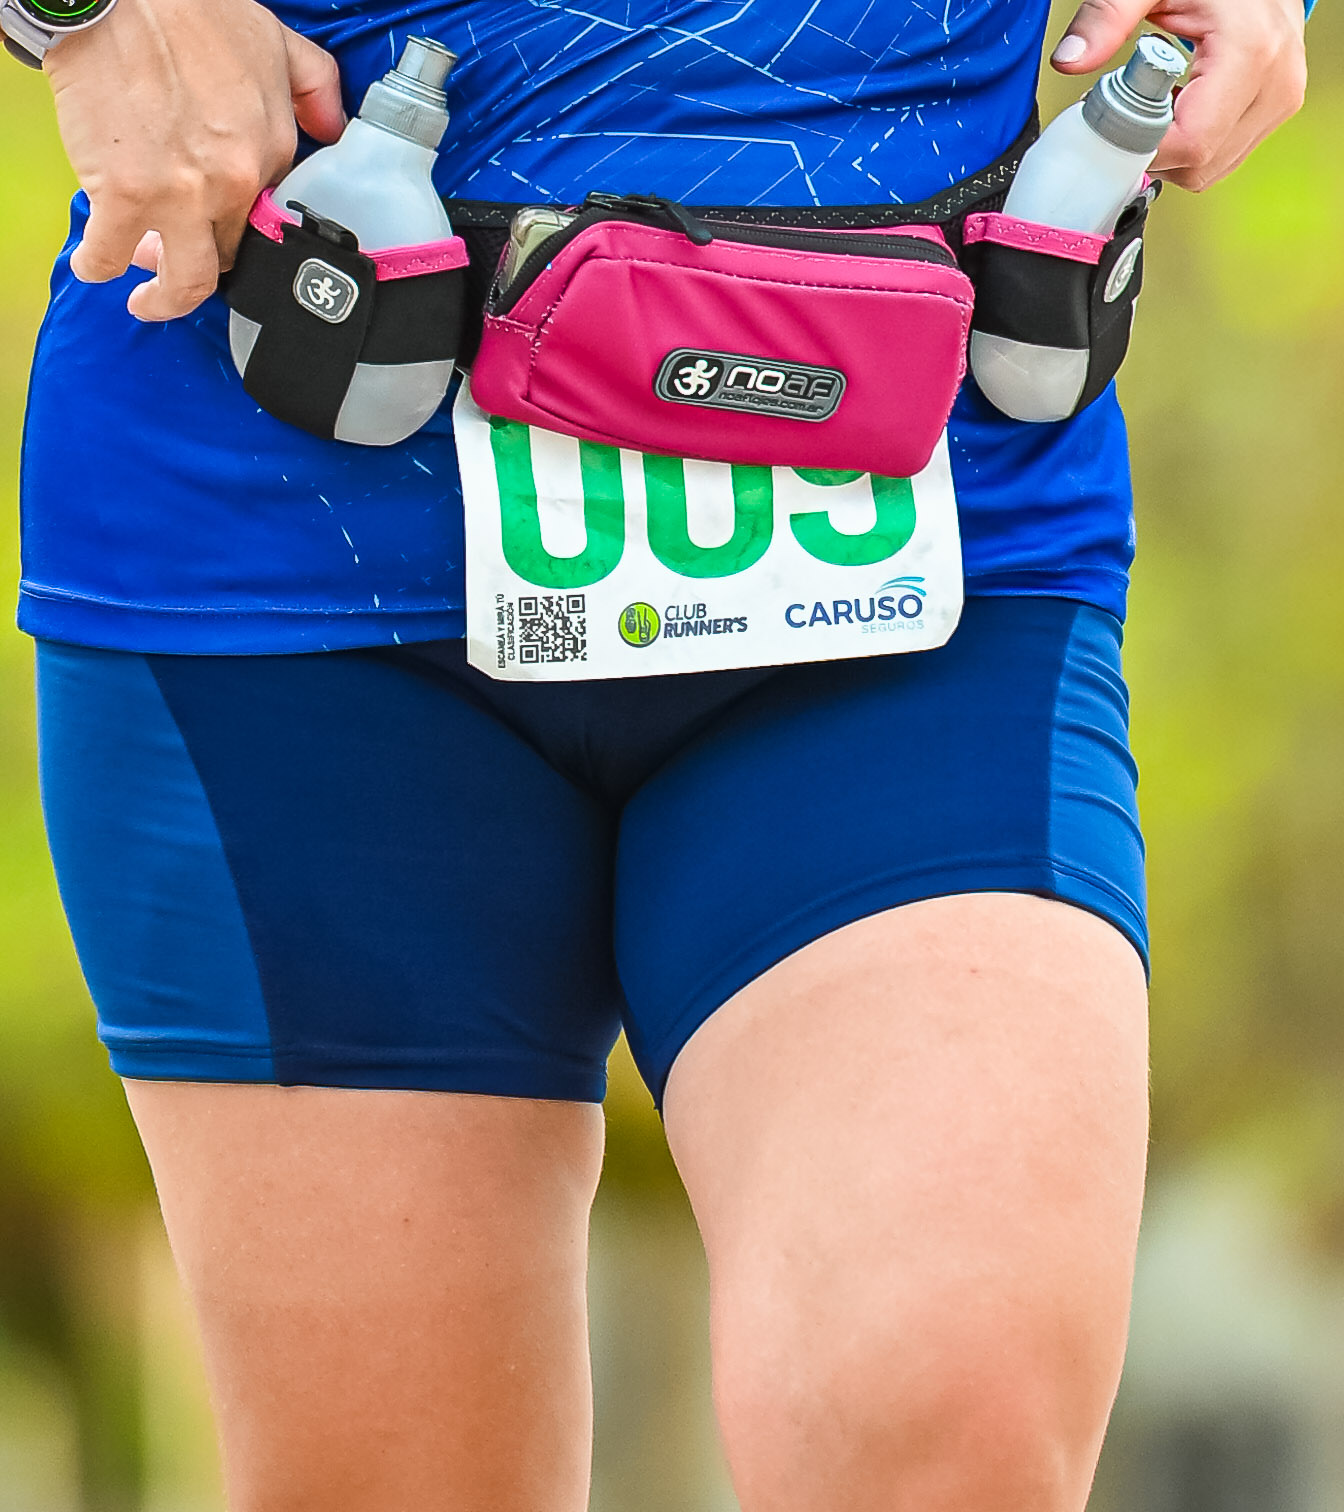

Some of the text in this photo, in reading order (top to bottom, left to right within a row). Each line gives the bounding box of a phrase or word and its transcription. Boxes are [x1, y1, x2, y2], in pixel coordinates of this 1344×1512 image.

[494, 593, 505, 604] TÚ
[664, 602, 707, 620] CLUB
[784, 594, 923, 628] CARUSO
[663, 616, 748, 639] RUNNER'S
[860, 619, 925, 634] SEGUROS
